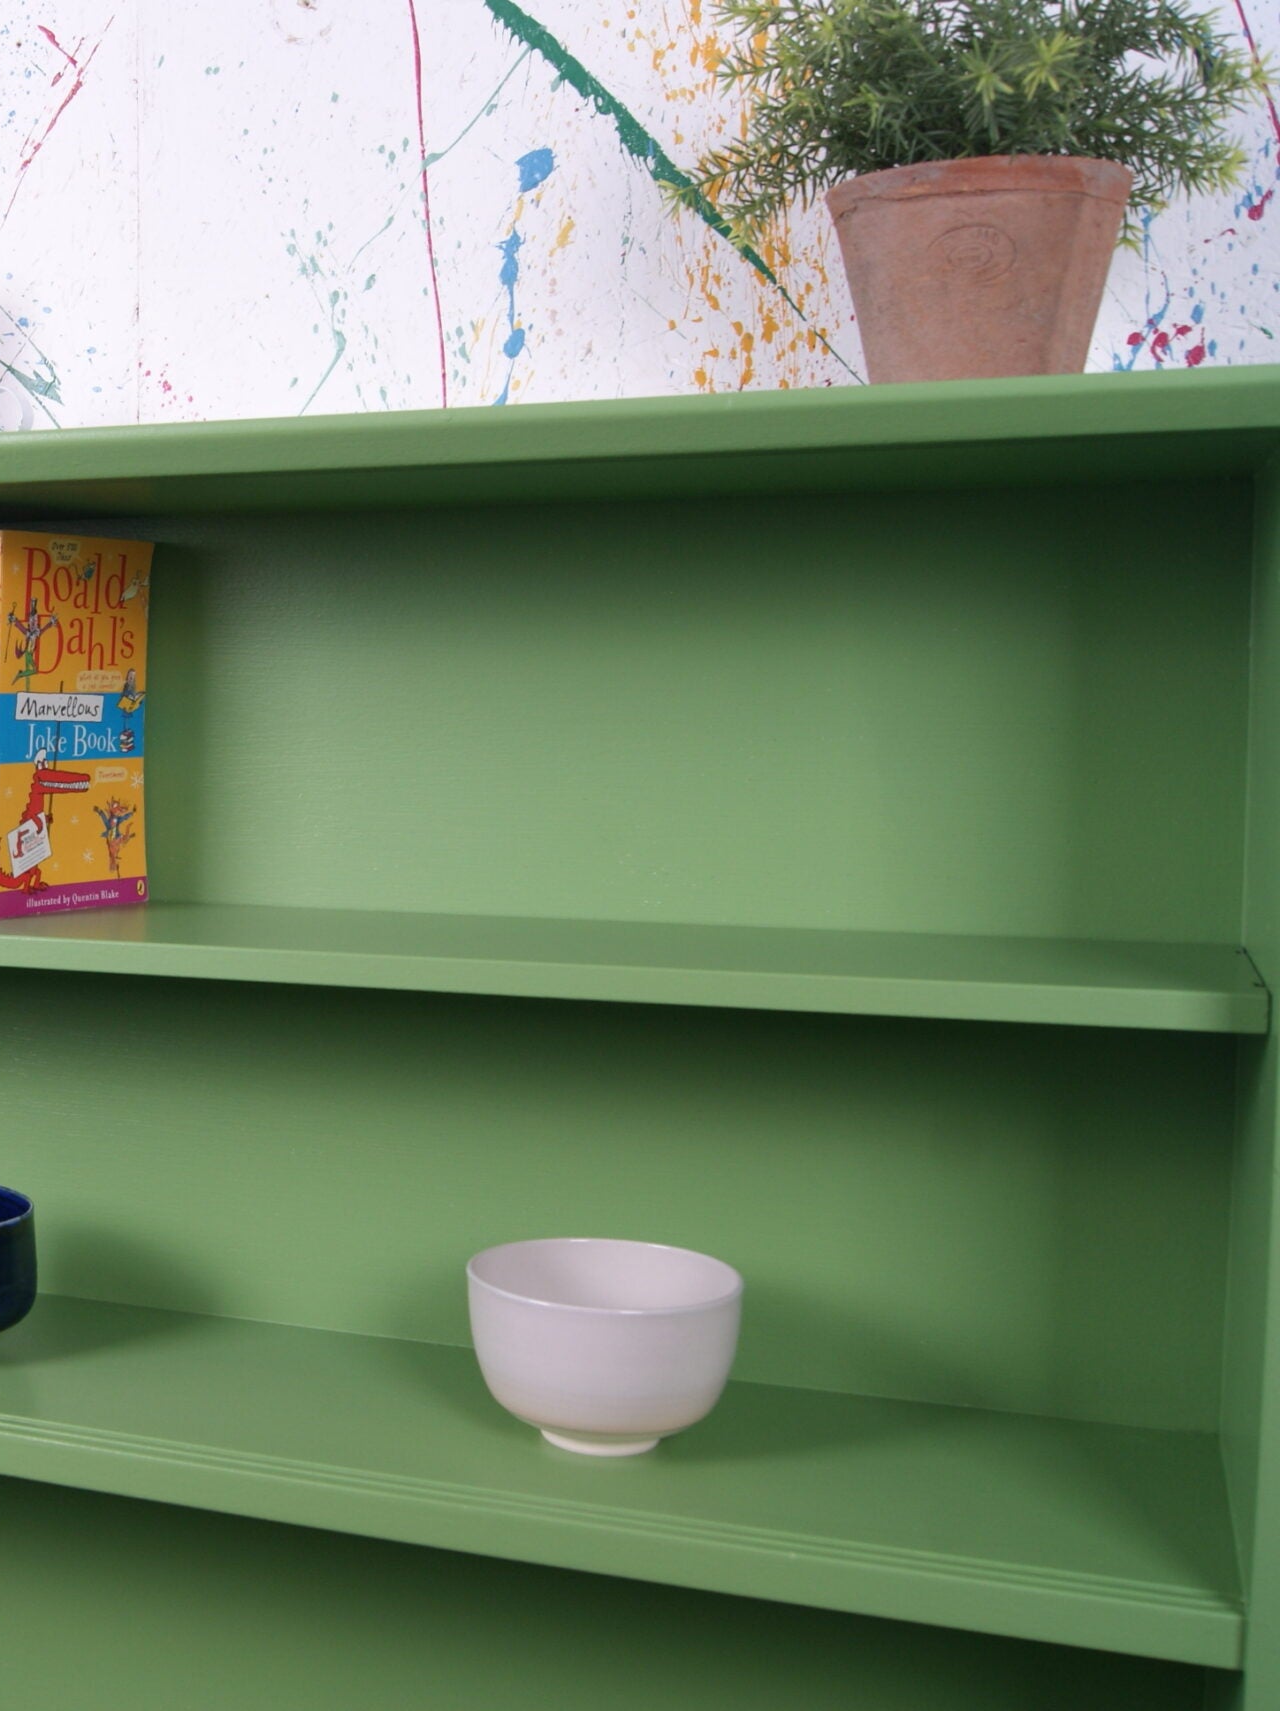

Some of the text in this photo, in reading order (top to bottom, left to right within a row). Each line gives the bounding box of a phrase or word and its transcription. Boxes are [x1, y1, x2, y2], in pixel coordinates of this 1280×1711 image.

[19, 546, 128, 622] Roald
[34, 613, 135, 675] Dahl's
[20, 695, 99, 718] Marvellous
[25, 723, 117, 759] Joke Book
[26, 889, 119, 908] illustrated by Quentin Blake
